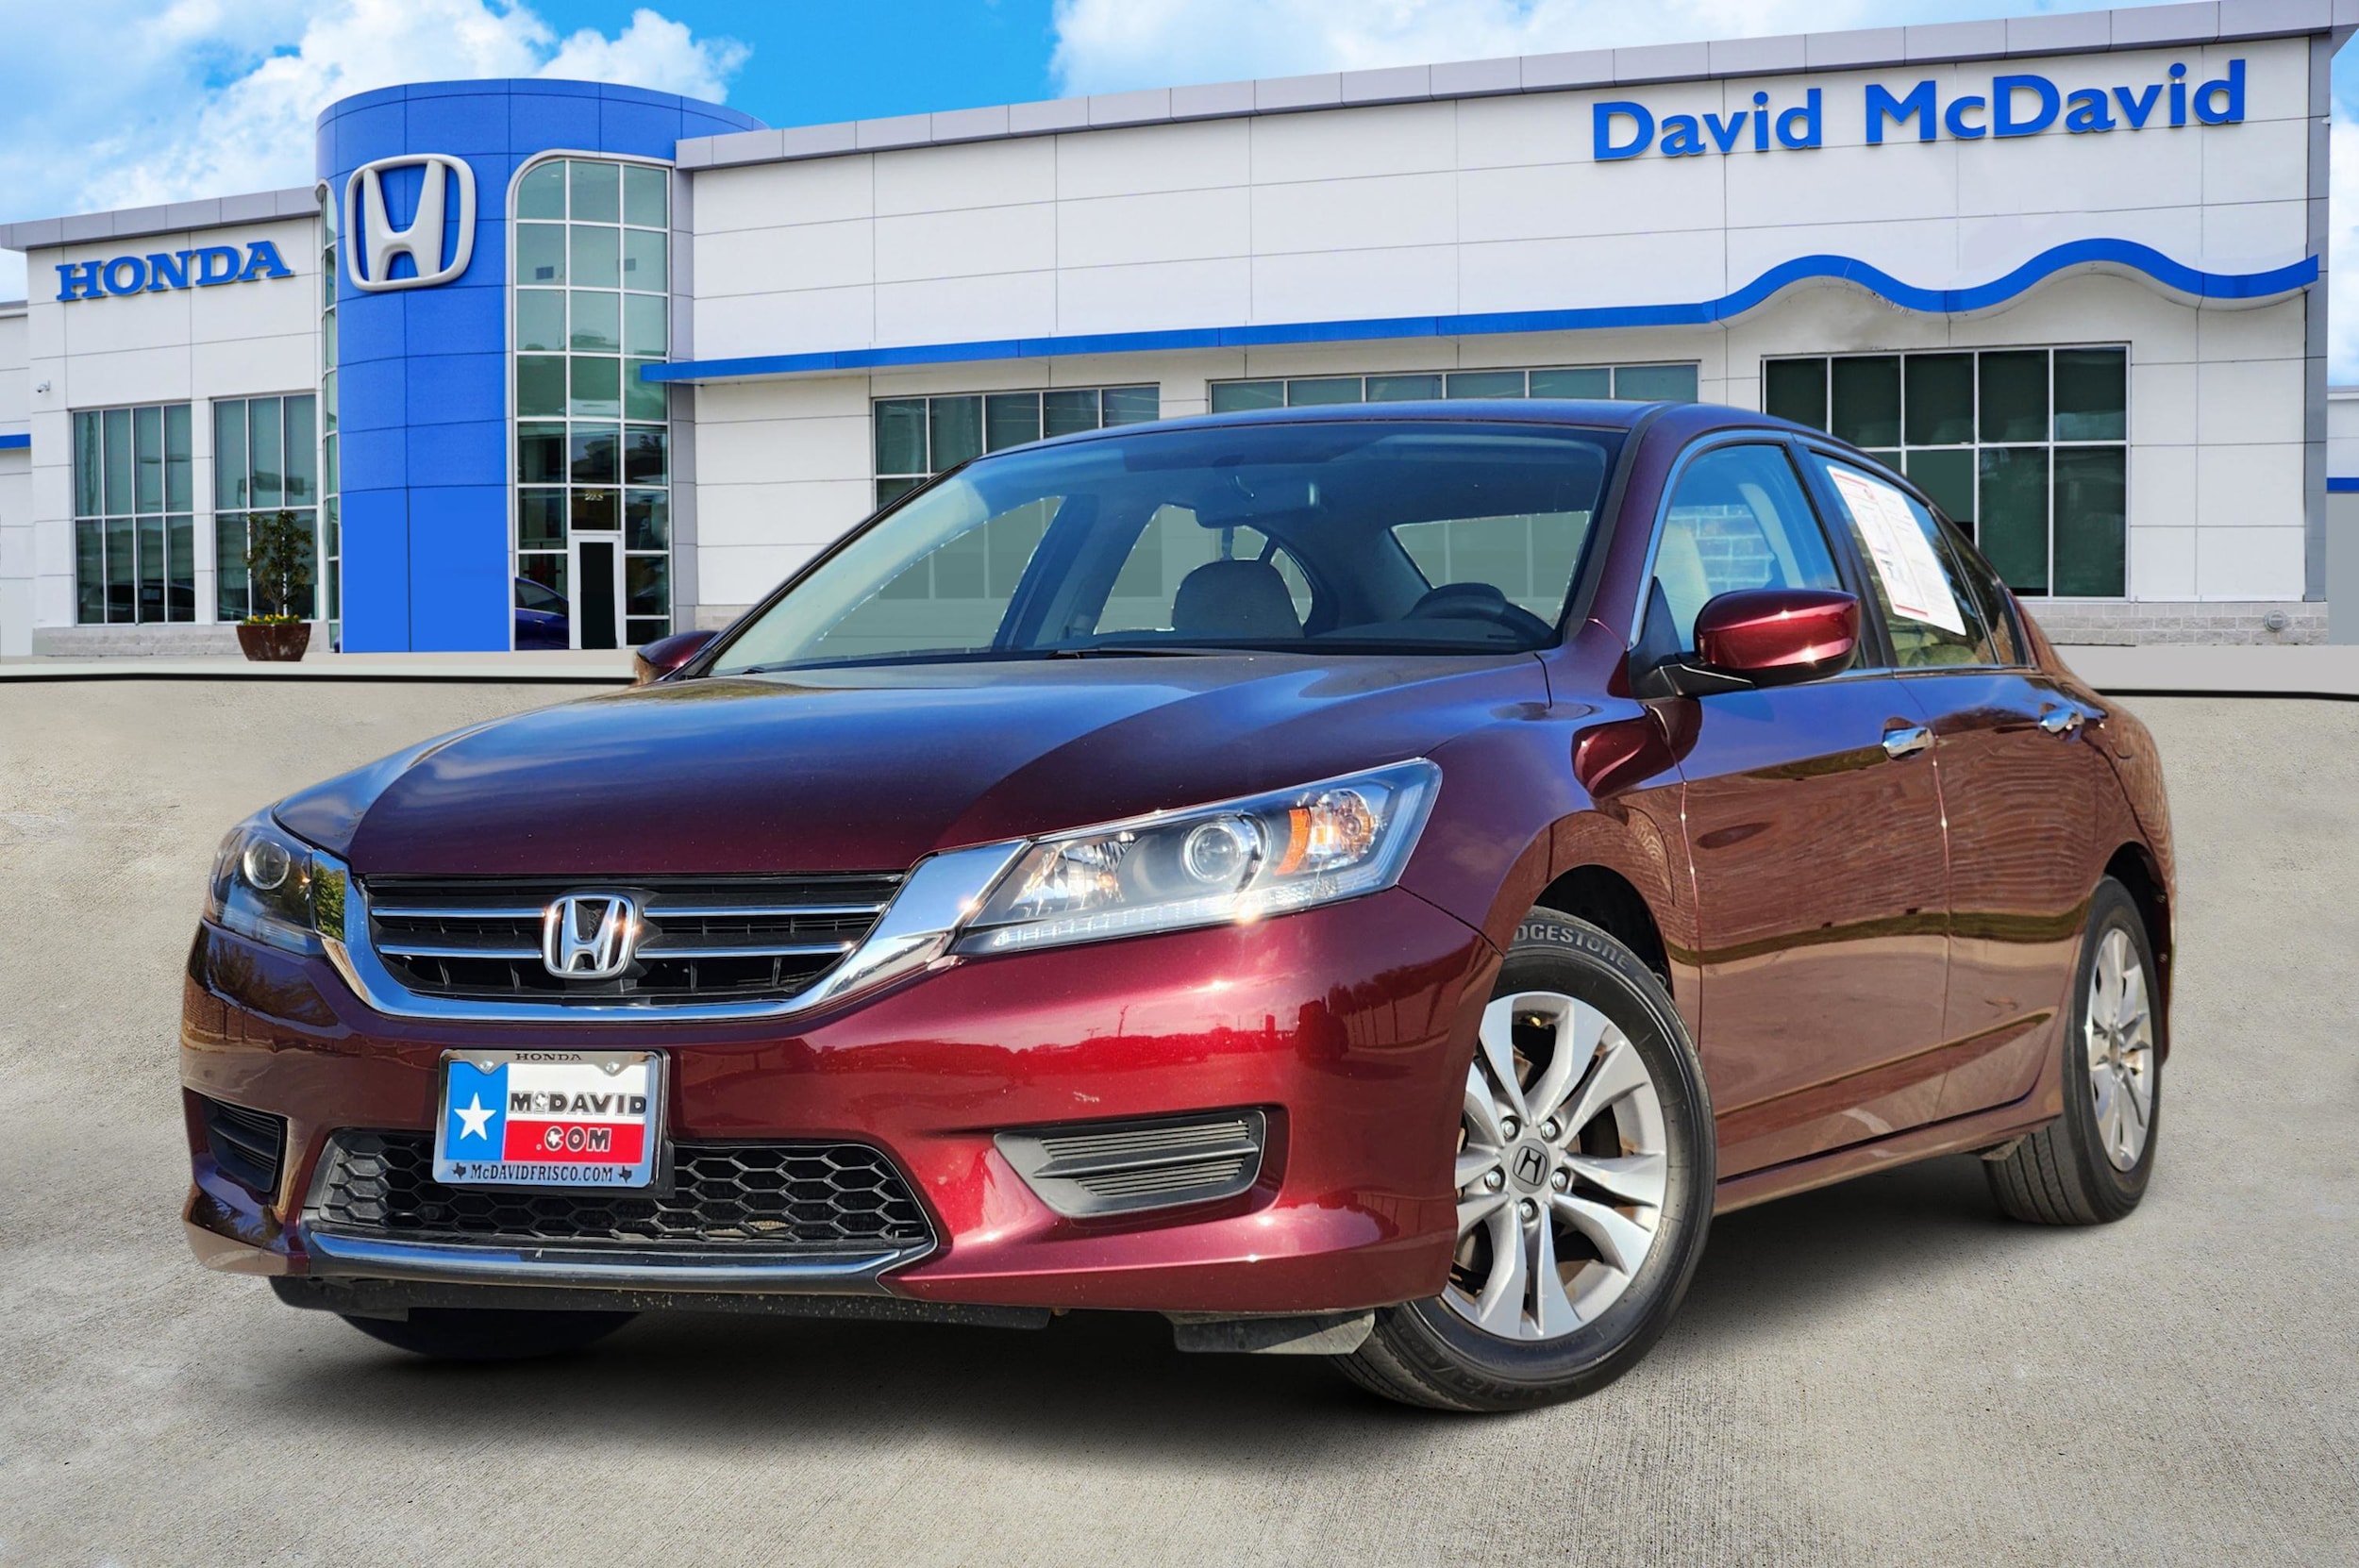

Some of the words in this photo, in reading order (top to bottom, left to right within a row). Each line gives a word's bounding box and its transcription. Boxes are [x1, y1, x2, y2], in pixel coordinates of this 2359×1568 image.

[1593, 87, 1822, 161] David
[1865, 58, 2247, 144] McDavid
[55, 241, 294, 301] HONDA
[1513, 924, 1631, 971] DGESTONE
[515, 1053, 581, 1061] HONDA
[536, 1125, 612, 1153] .COM
[470, 1164, 613, 1182] McDAVIDFRISCO.COM
